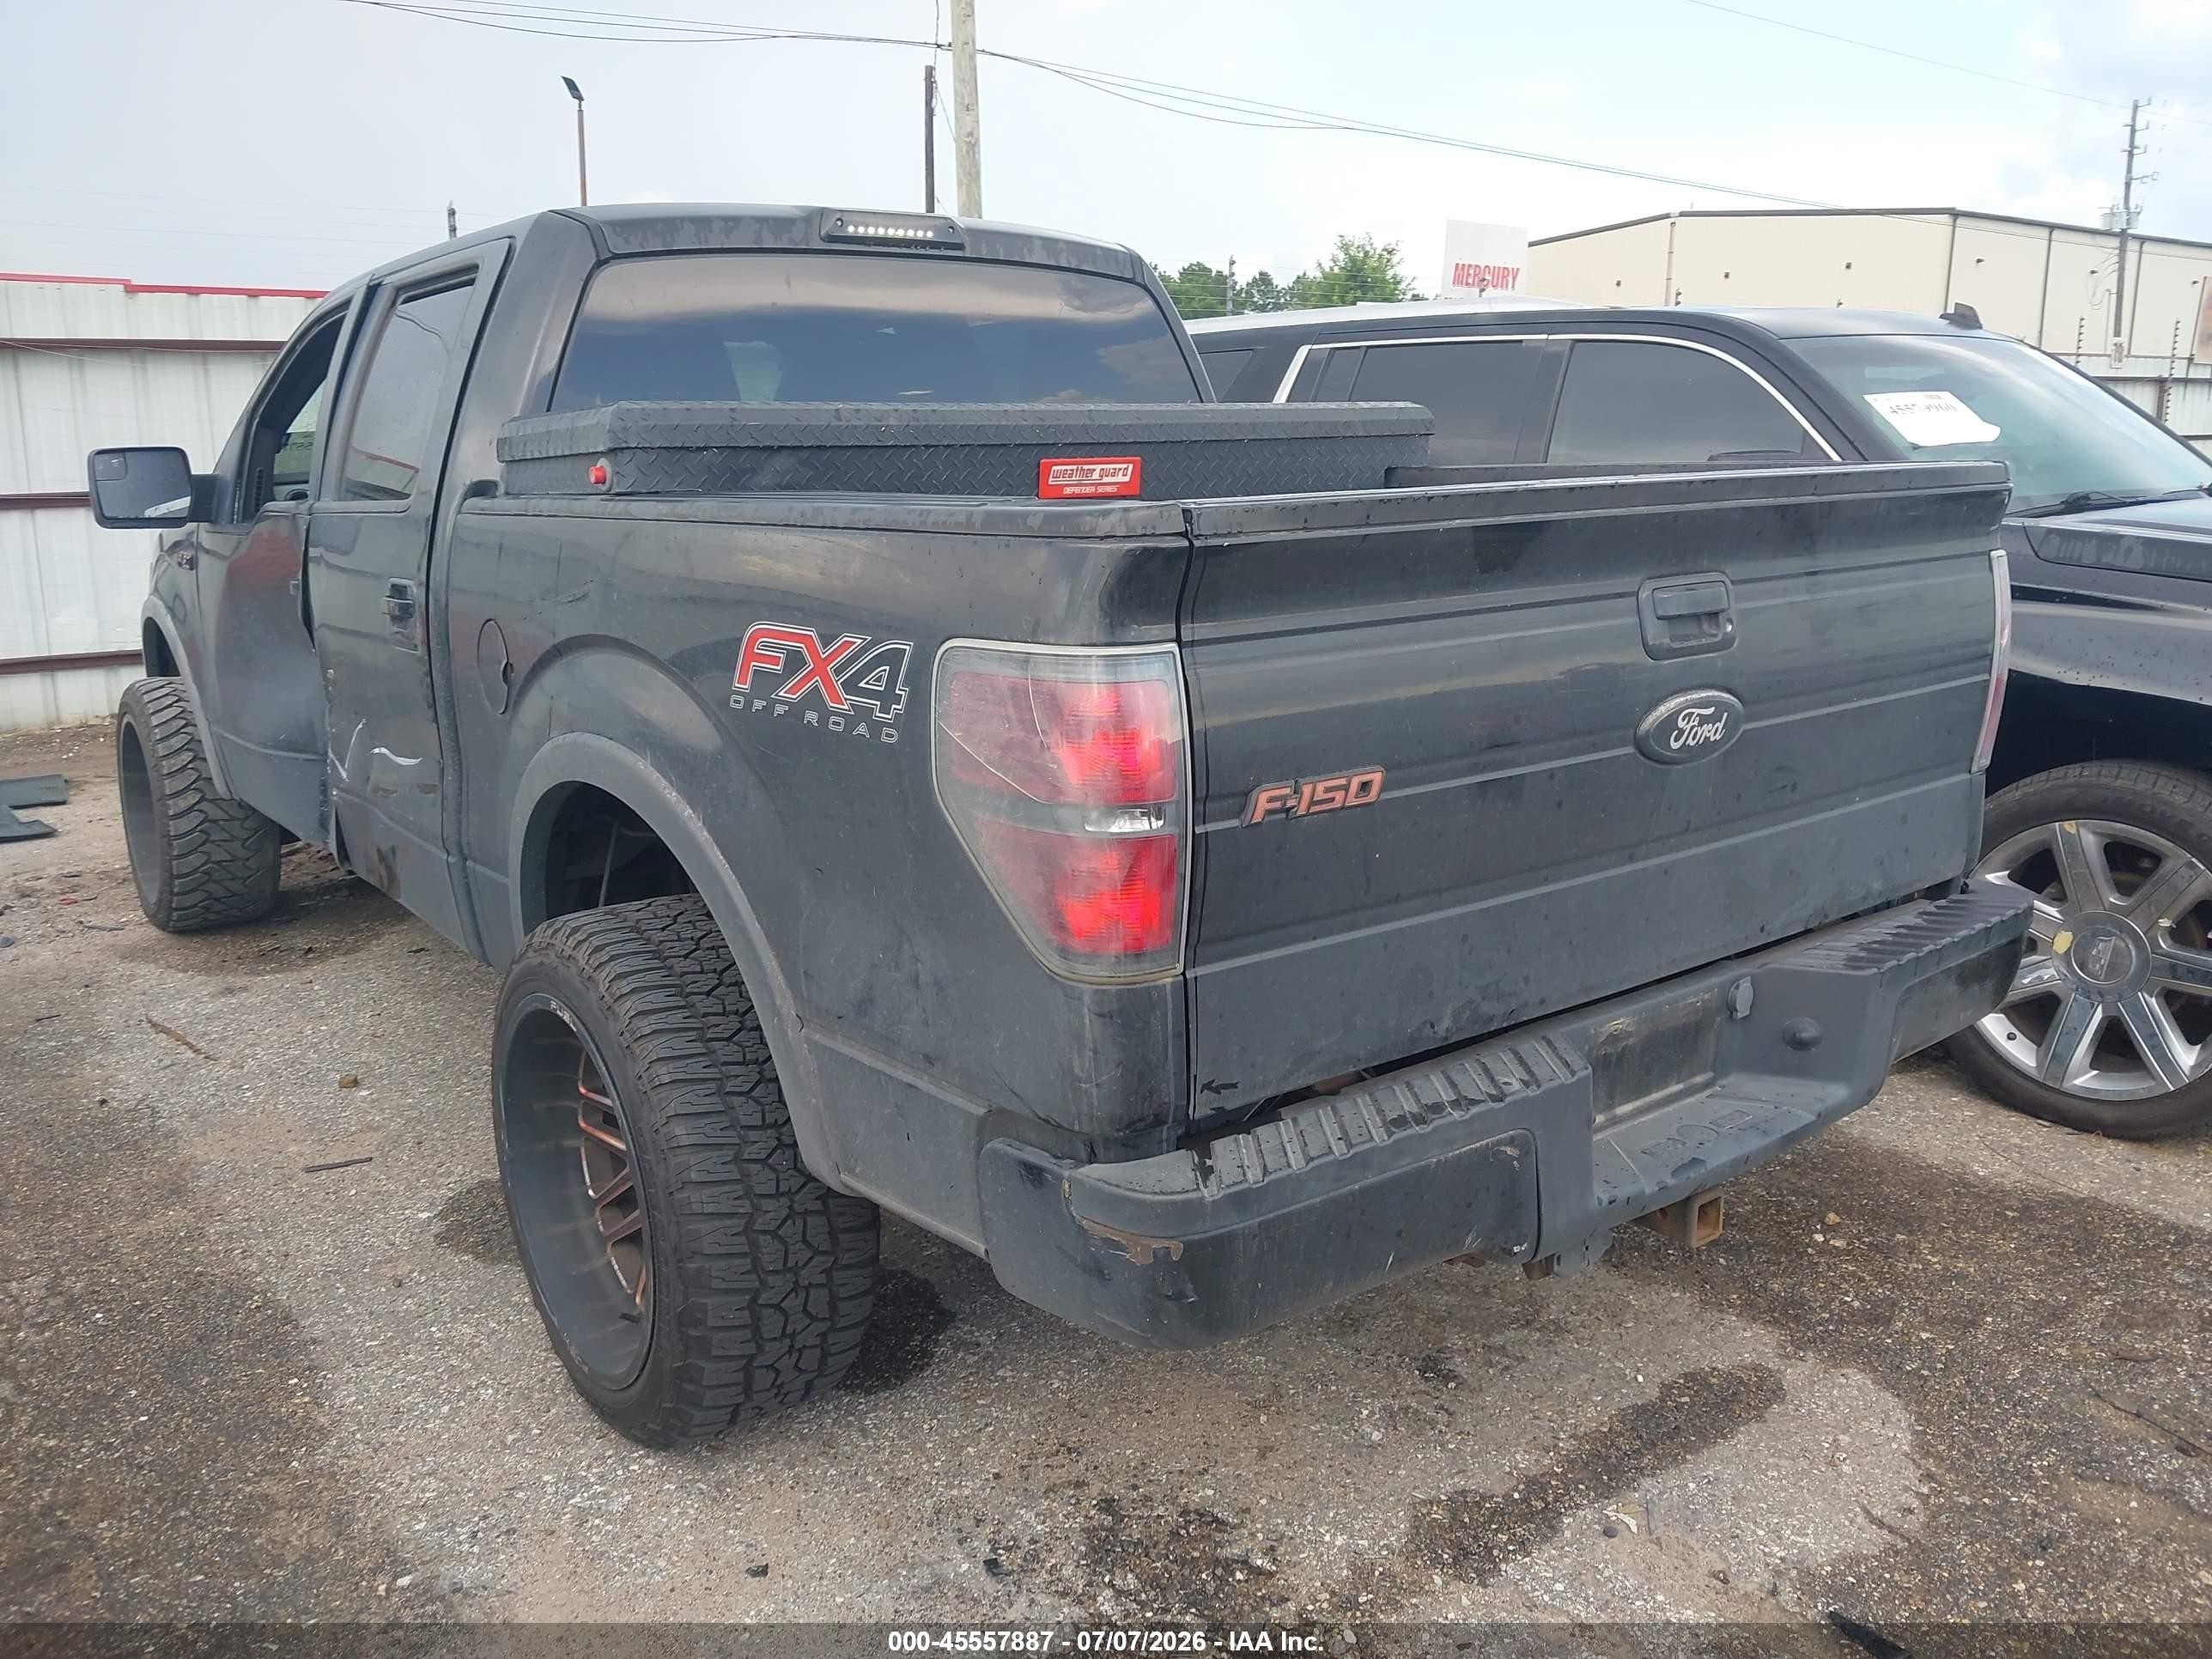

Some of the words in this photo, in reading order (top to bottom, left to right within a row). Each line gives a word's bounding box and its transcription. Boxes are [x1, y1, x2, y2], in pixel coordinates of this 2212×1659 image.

[1452, 263, 1521, 290] MERCURY
[1052, 466, 1097, 479] weather
[1098, 465, 1130, 481] guard
[732, 621, 915, 723] FX4
[729, 694, 789, 717] OFF
[804, 710, 898, 744] ROAD
[1669, 706, 1729, 750] Ford
[1240, 765, 1386, 829] F-150
[550, 1000, 577, 1032] FUEL
